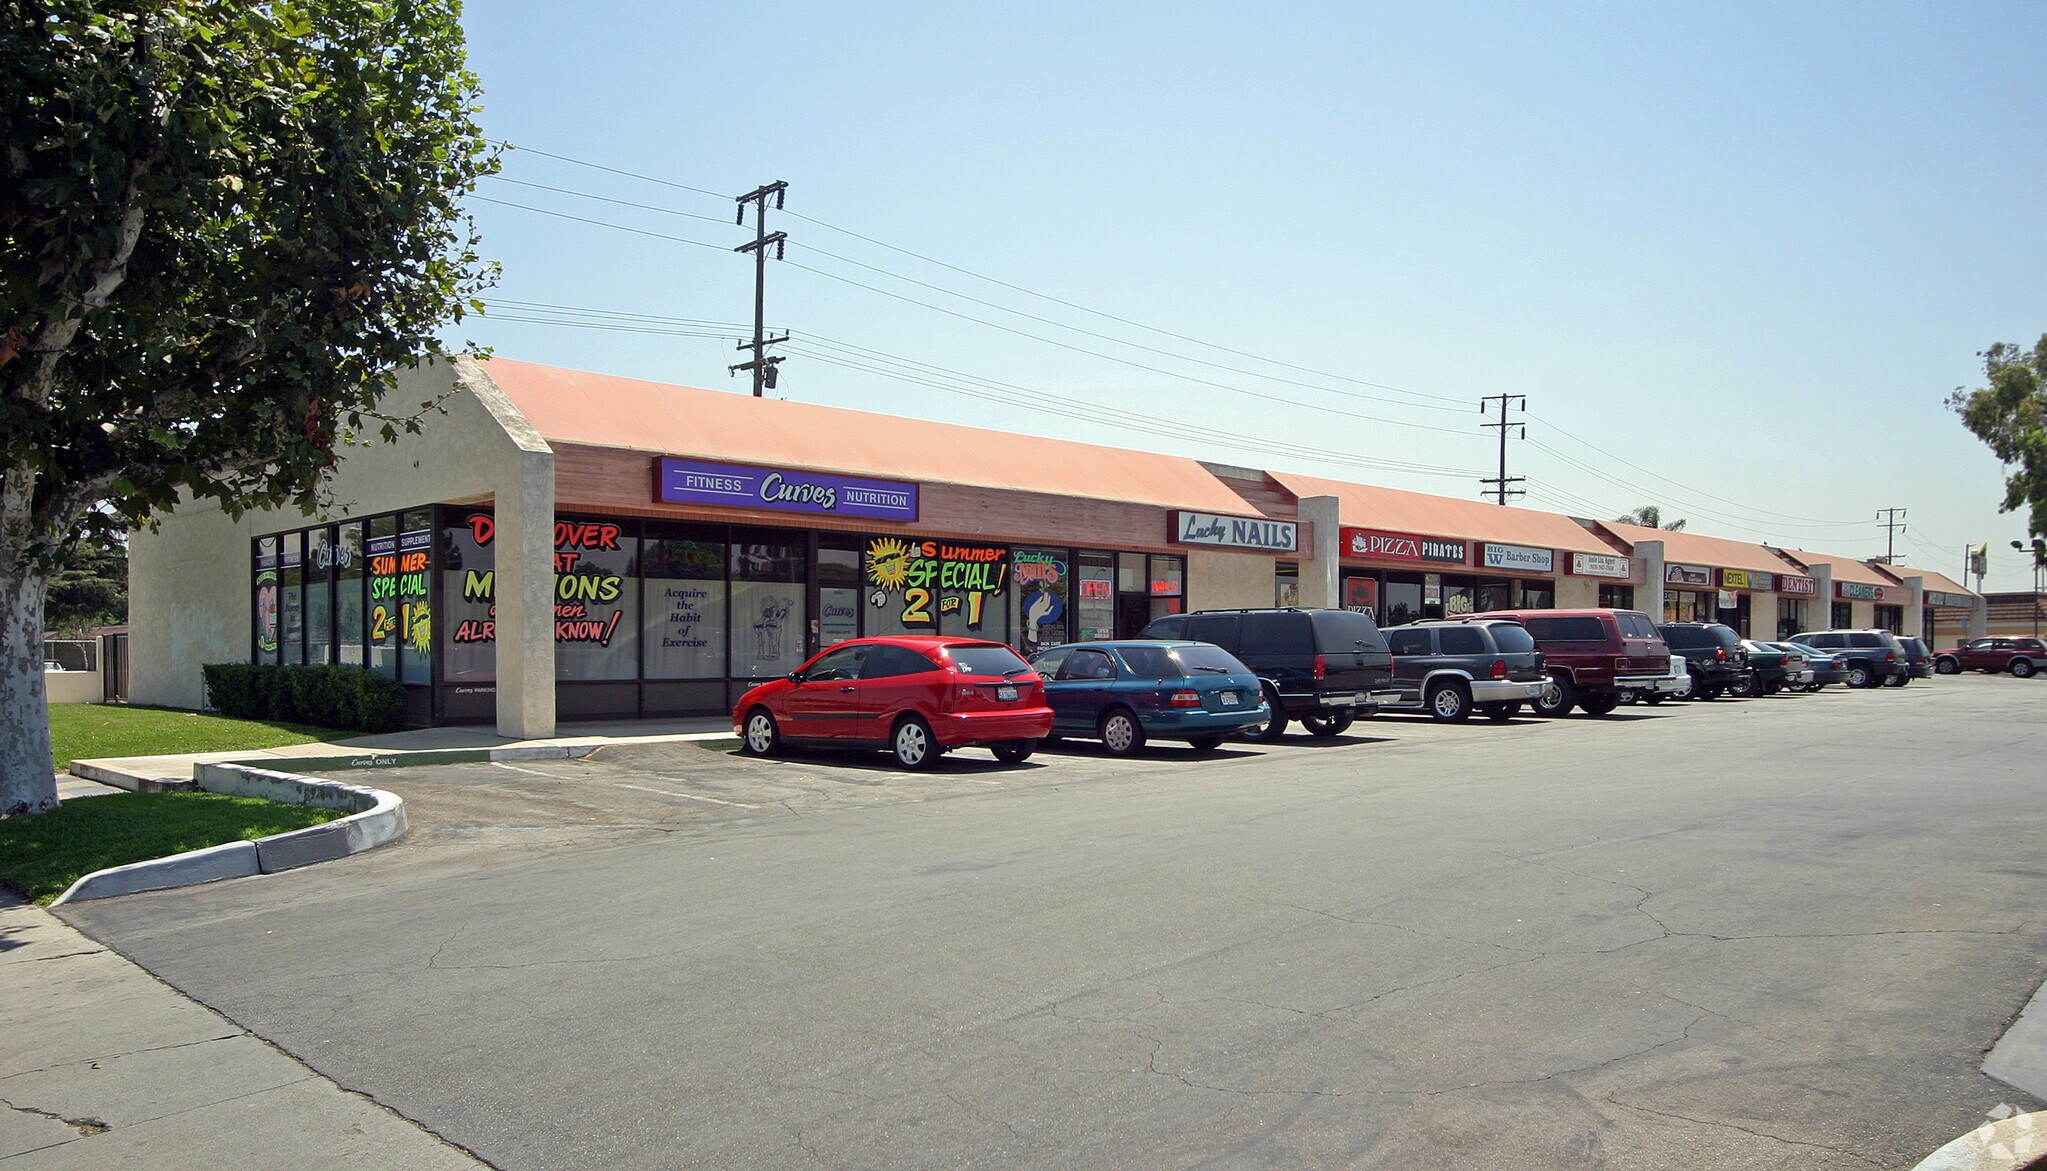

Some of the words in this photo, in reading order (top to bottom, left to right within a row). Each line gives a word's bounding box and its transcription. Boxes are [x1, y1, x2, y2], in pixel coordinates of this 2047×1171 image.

[686, 475, 742, 492] FITNESS
[759, 473, 837, 509] Curves
[846, 490, 907, 506] NUTRITION
[1183, 515, 1226, 542] Lucky
[1231, 520, 1292, 548] NAILS
[371, 540, 395, 552] NUTRITION
[921, 541, 1007, 562] Summer
[1370, 535, 1419, 557] PIZZA
[1422, 541, 1464, 559] PIRATES
[1487, 545, 1504, 554] BIG
[372, 553, 427, 575] SUMMER
[1013, 551, 1061, 571] Lucky
[1487, 553, 1504, 565] W
[1506, 551, 1531, 562] Barber
[1532, 553, 1550, 567] Shop
[1151, 580, 1178, 592] NAILS
[1724, 571, 1744, 585] NEXTEL
[1782, 576, 1814, 592] DENTIST
[371, 573, 427, 600] SPECIAL
[663, 588, 708, 599] Acquire
[1081, 581, 1110, 597] OPEN
[1849, 584, 1874, 599] CLEANERS
[676, 600, 695, 610] the
[822, 603, 855, 618] Curves
[902, 587, 931, 622] 2
[941, 599, 957, 609] FOR
[967, 591, 982, 625] 1
[1449, 594, 1468, 613] BIG
[372, 604, 387, 640] 2
[401, 602, 411, 640] 1
[670, 613, 702, 623] Habit
[555, 610, 622, 646] KNOW!
[678, 625, 691, 636] of
[662, 637, 708, 648] Exercise
